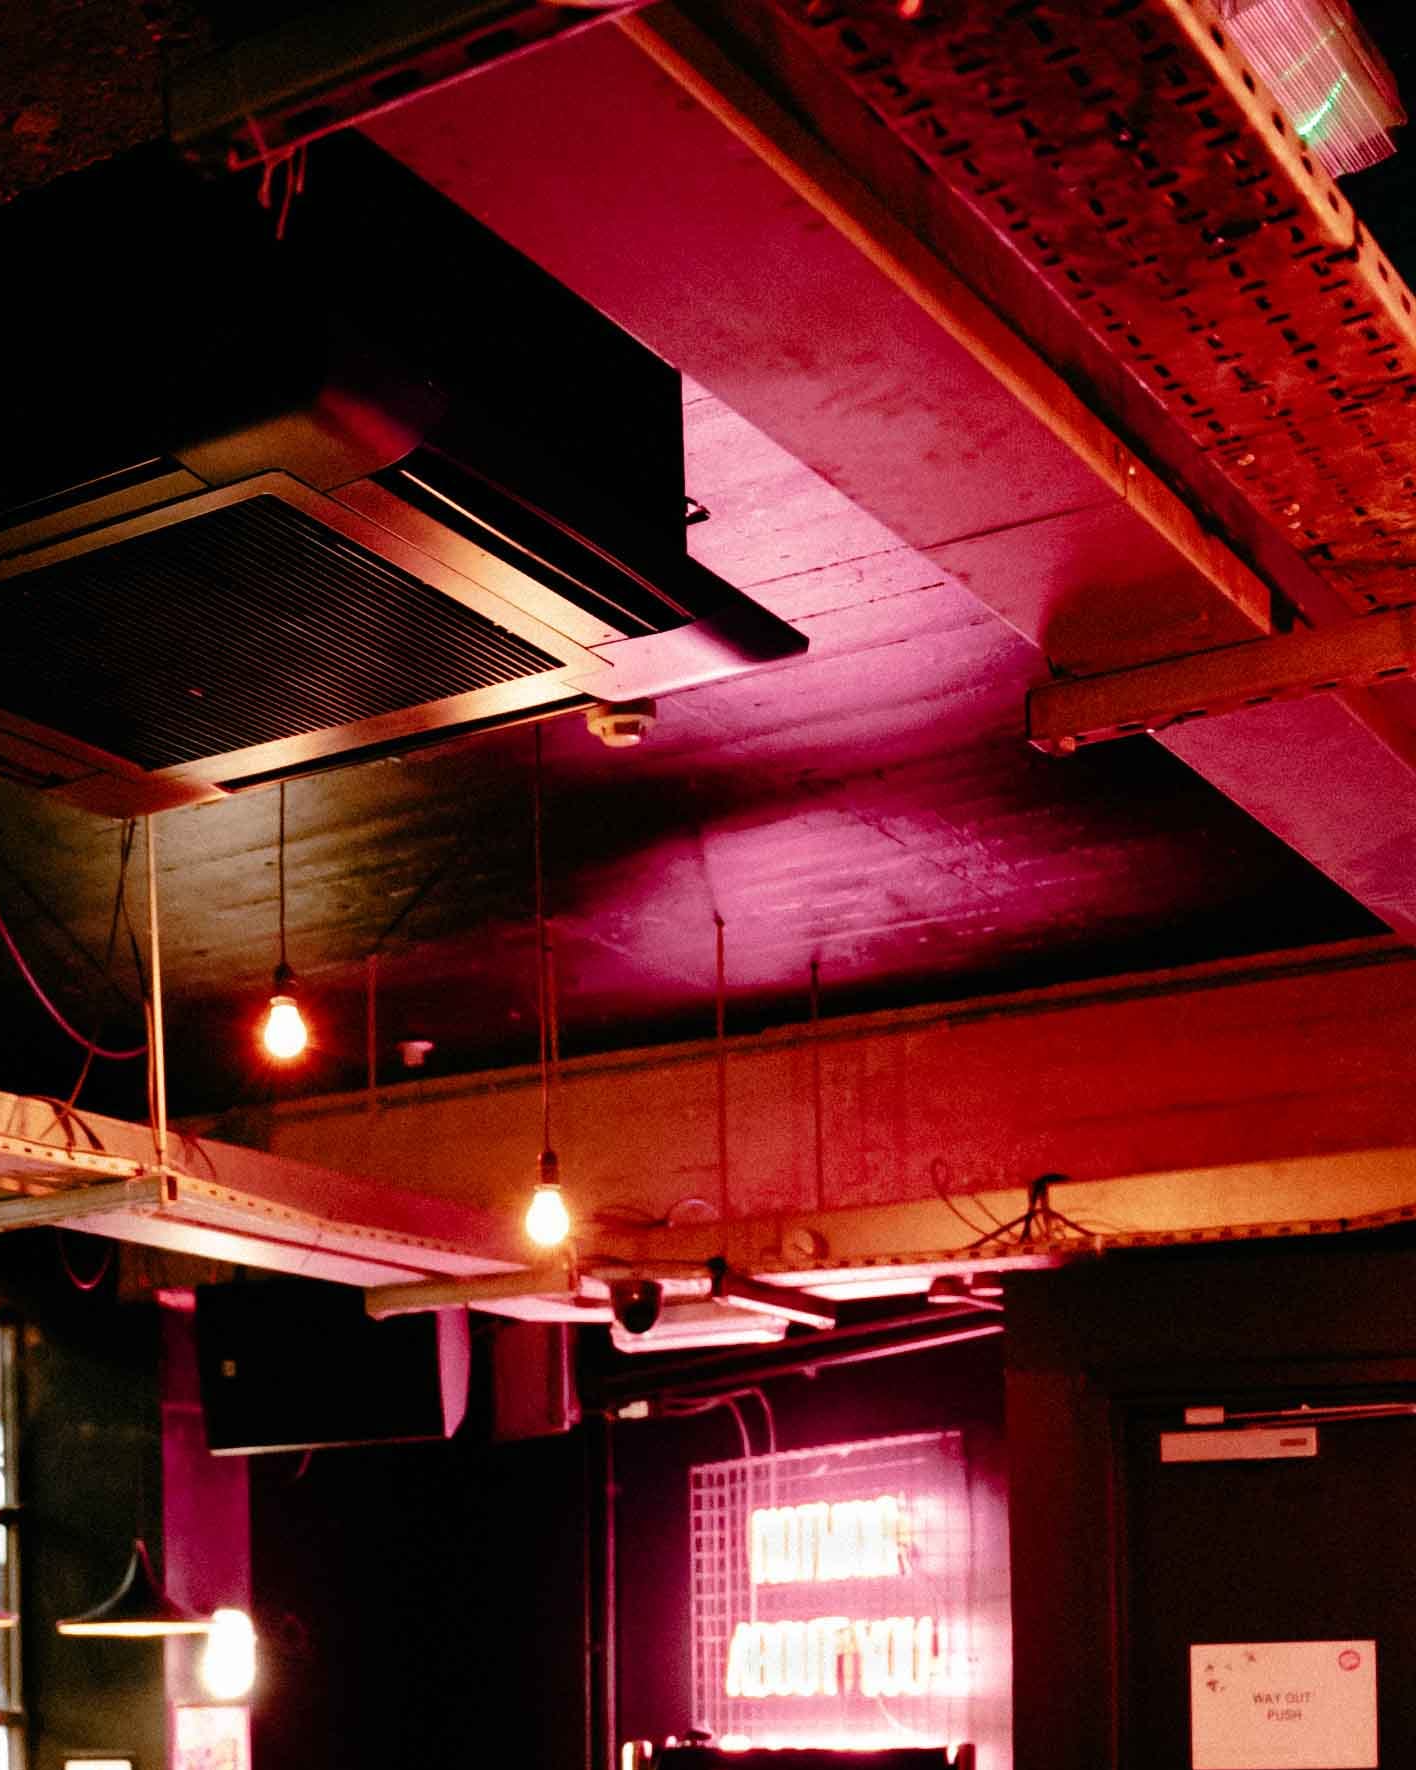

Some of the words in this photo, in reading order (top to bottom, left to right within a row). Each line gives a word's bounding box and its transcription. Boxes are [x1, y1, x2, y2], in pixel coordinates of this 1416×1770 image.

[726, 1616, 850, 1697] ABOUT
[854, 1616, 934, 1697] YOU
[1253, 1692, 1281, 1705] WAY
[1285, 1692, 1312, 1704] OUT
[1267, 1709, 1302, 1721] PUSH
